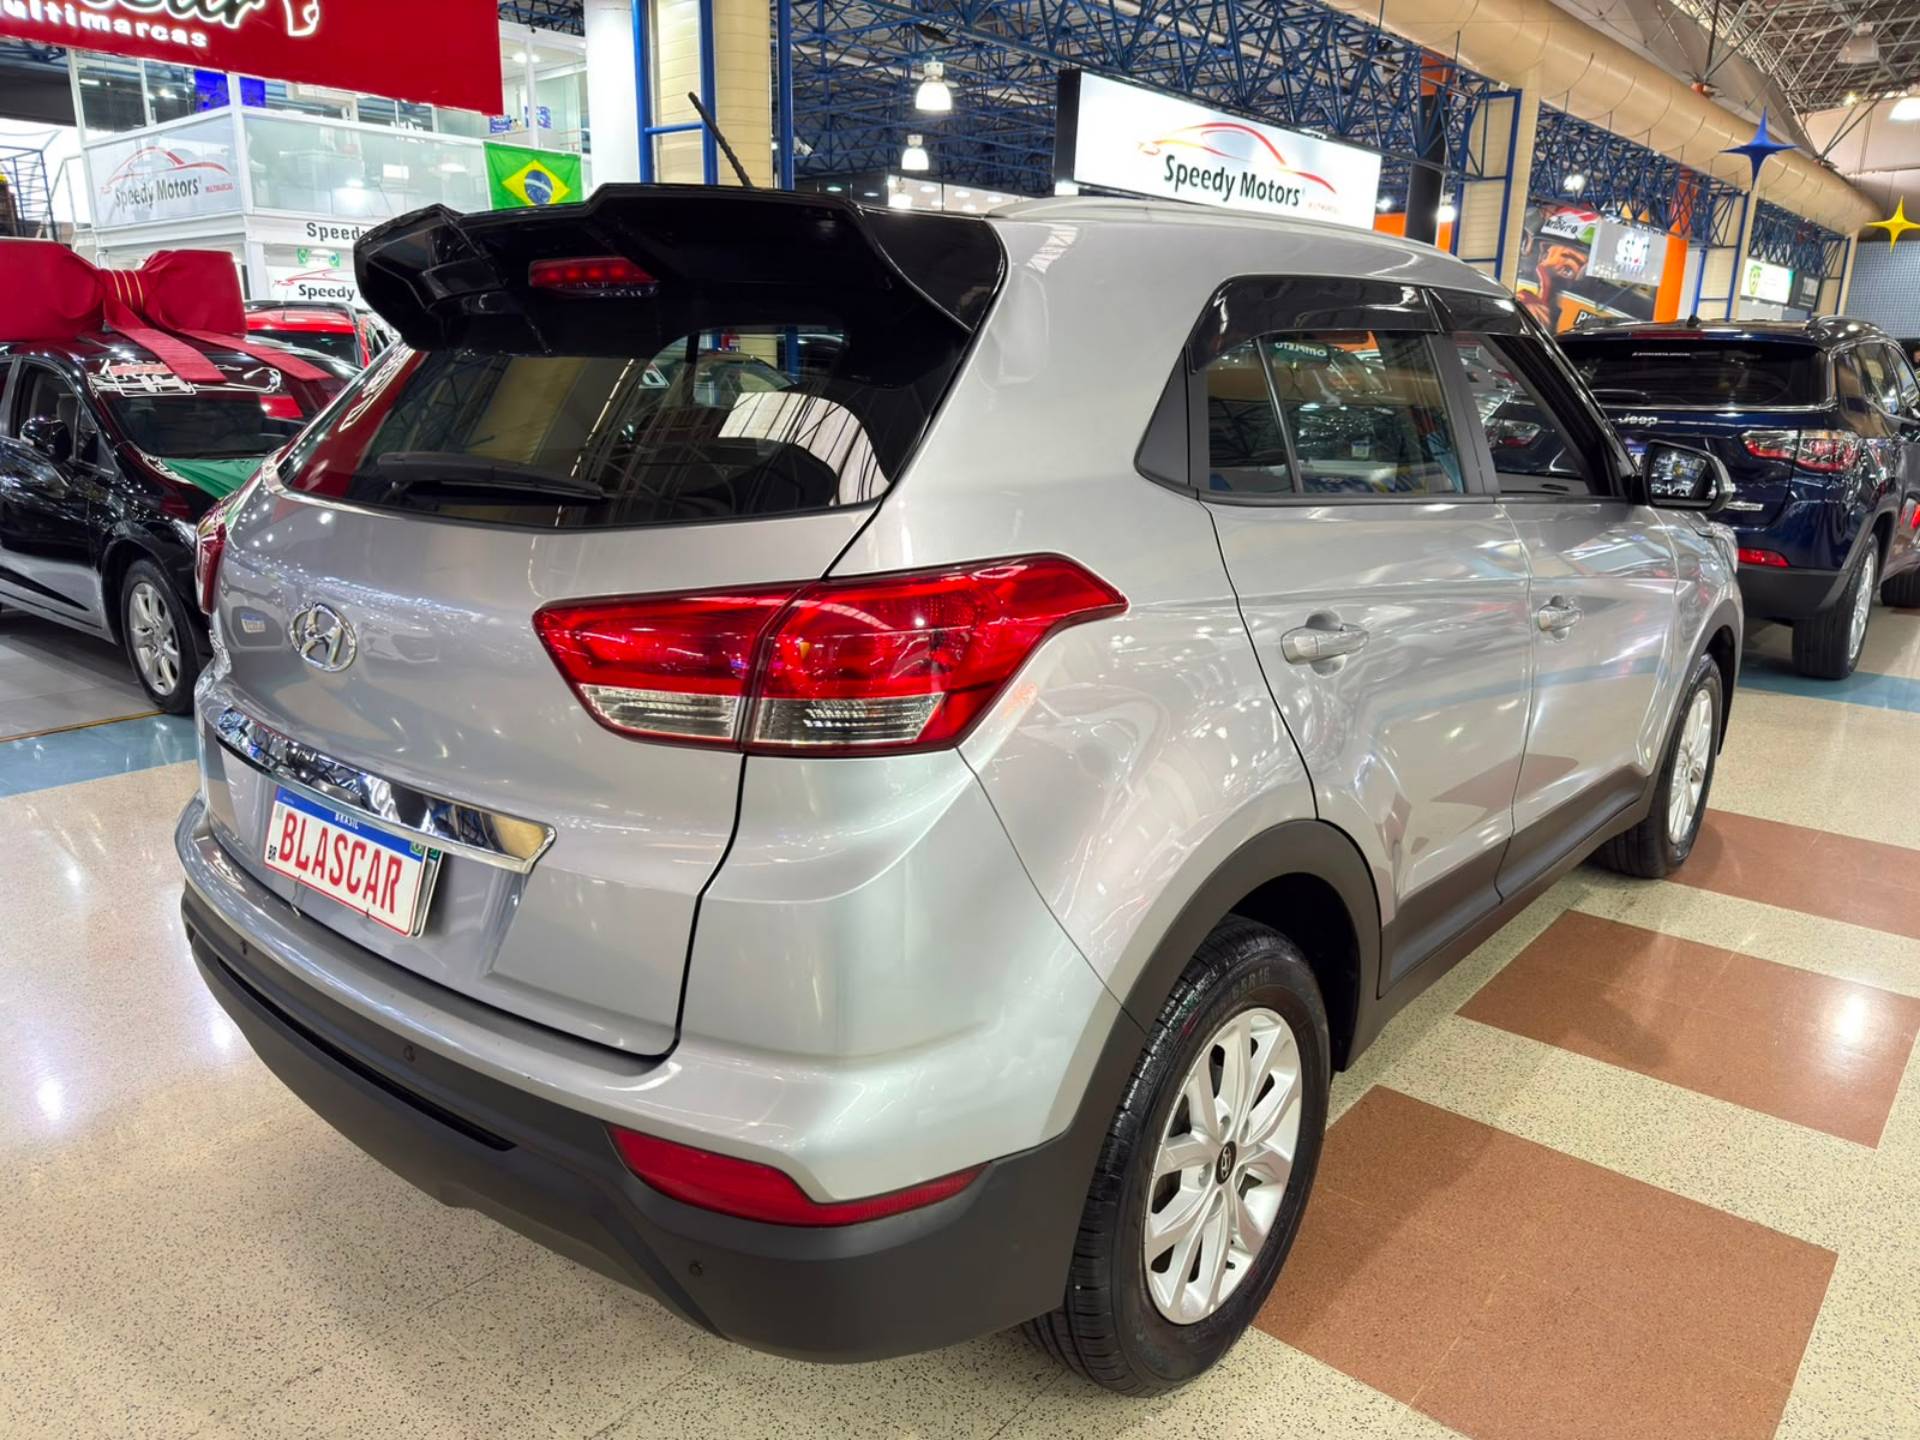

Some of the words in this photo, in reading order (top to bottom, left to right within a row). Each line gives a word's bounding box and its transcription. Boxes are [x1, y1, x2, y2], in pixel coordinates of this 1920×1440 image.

[0, 0, 208, 47] ultimarcas
[115, 182, 154, 212] Speedy
[156, 178, 199, 201] Motors
[1164, 154, 1236, 202] Speedy
[1240, 171, 1300, 207] Motors
[306, 222, 367, 241] Speed
[298, 284, 355, 301] Speedy
[1618, 413, 1657, 428] Jeep
[279, 811, 402, 914] BLASCAR
